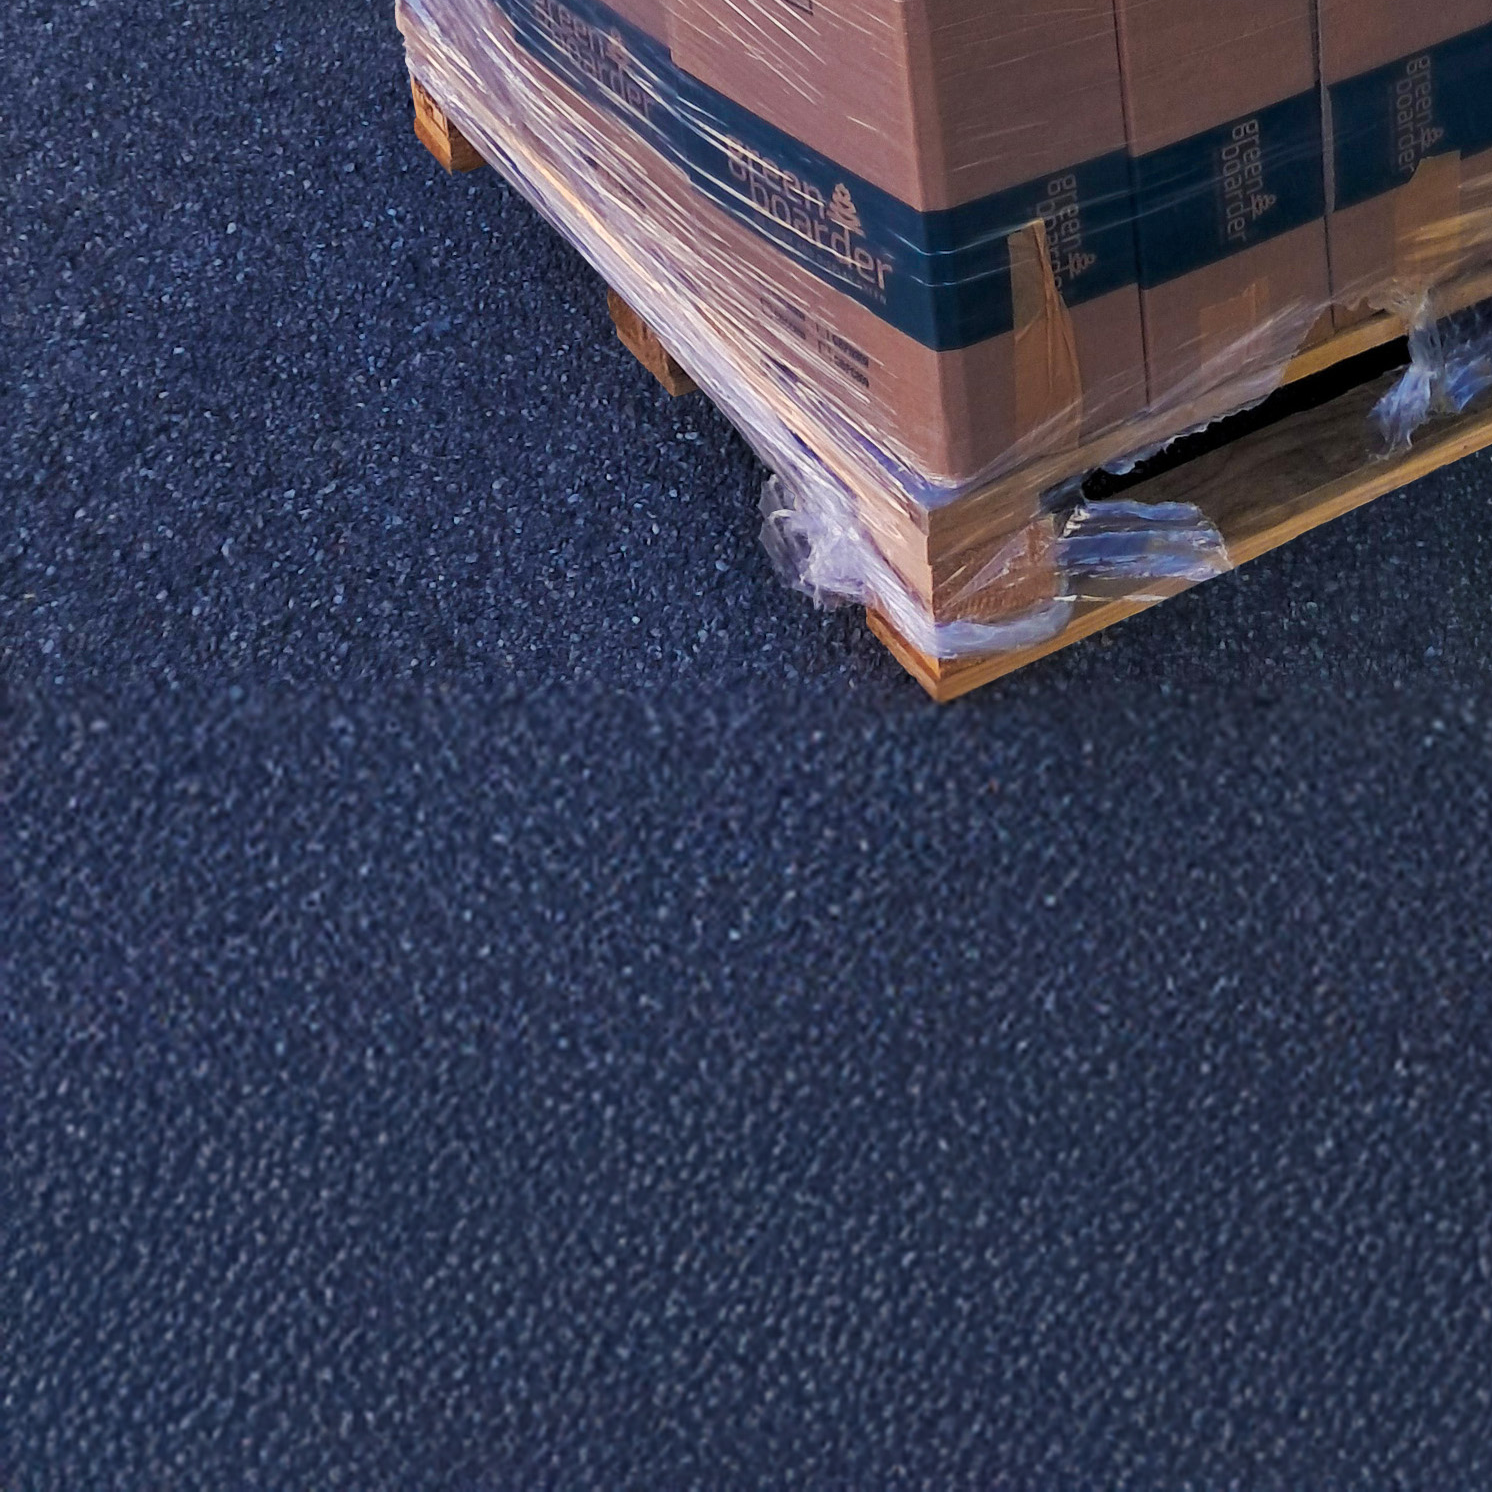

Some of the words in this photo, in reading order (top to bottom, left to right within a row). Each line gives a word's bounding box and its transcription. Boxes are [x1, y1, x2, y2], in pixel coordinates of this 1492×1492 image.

[1395, 78, 1415, 172] boarder
[1407, 55, 1432, 128] green
[726, 134, 828, 215] green
[1221, 145, 1246, 241] boarder
[1232, 119, 1262, 195] green
[749, 172, 893, 289] boarder
[1048, 175, 1081, 253] green
